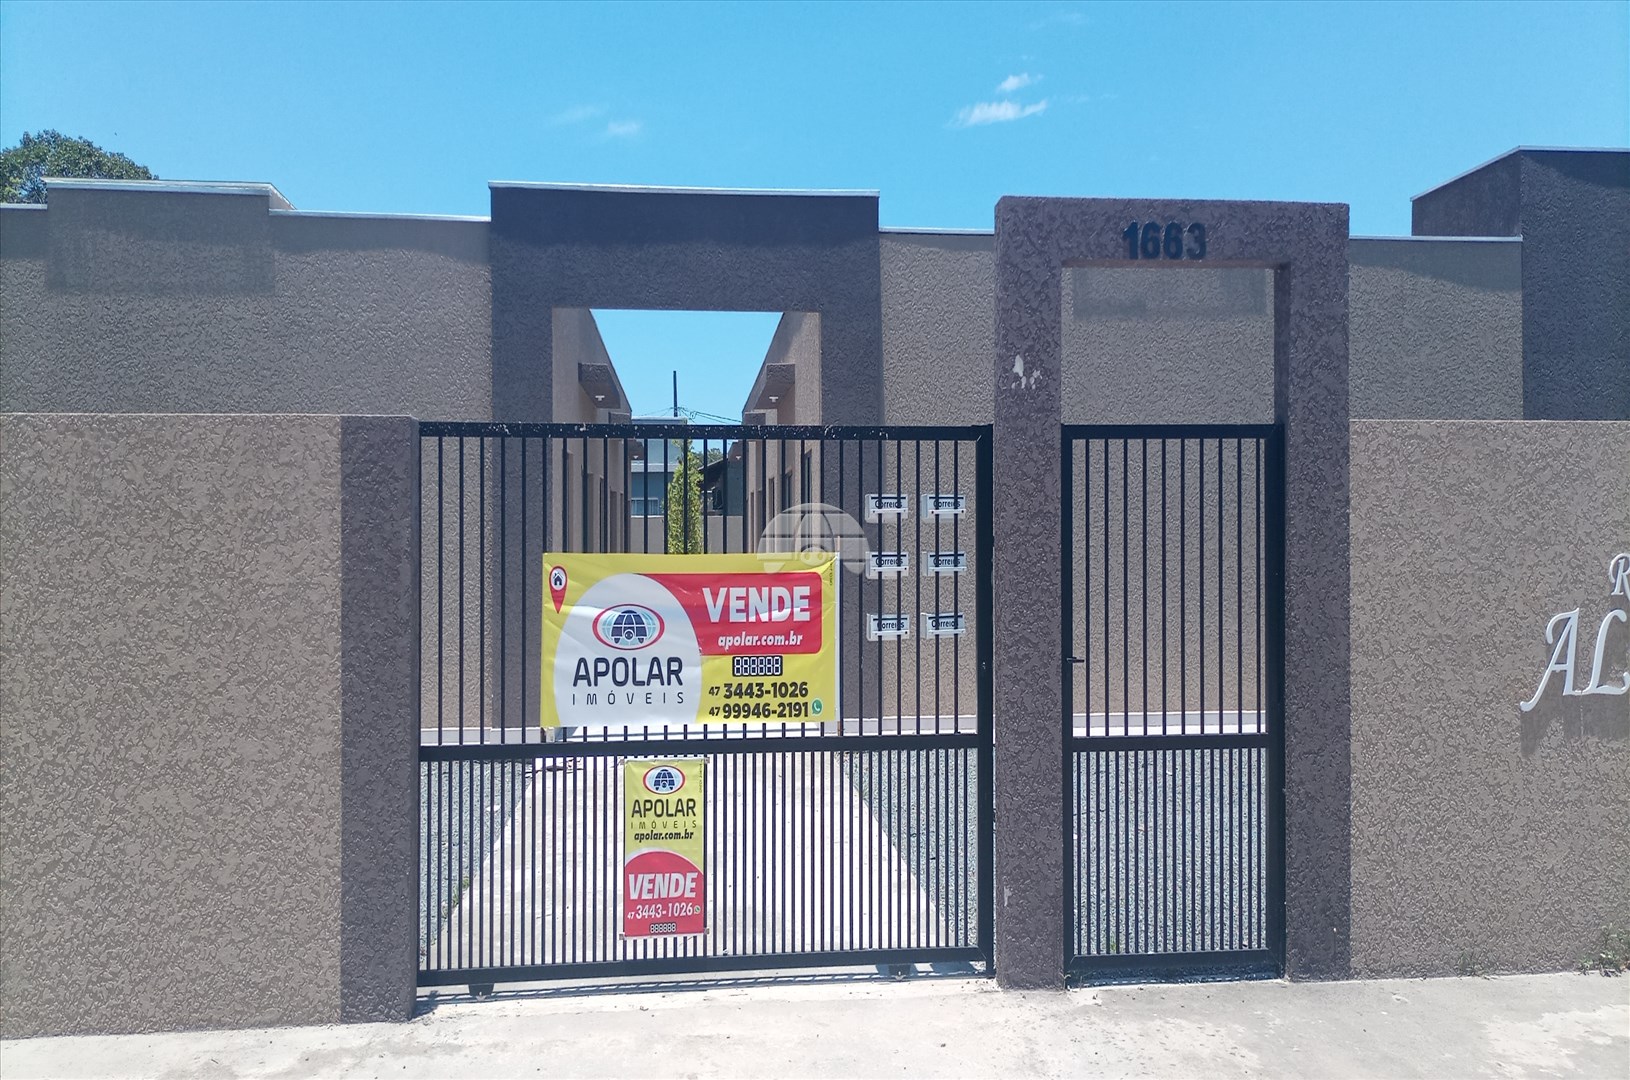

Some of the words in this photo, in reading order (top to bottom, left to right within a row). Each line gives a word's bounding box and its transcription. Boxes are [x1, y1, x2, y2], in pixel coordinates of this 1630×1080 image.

[1122, 221, 1206, 260] 1663
[933, 500, 961, 508] orreis
[875, 557, 904, 566] Correis
[933, 557, 961, 566] orreis
[702, 586, 810, 623] VENDE
[876, 622, 905, 630] orreis
[931, 619, 958, 628] Crreio
[718, 631, 803, 651] apolar.com.br
[573, 657, 683, 687] APOLAR
[572, 690, 684, 705] IMÓVEIS
[708, 687, 720, 696] 47
[723, 682, 809, 699] 3443-1026
[708, 707, 720, 717] 47
[722, 702, 809, 719] 99946-2191
[631, 798, 696, 818] APOLAR
[634, 829, 694, 843] apolar.com.br
[628, 873, 698, 900] VENDE
[627, 911, 635, 919] 47
[636, 902, 693, 919] 3443-1026
